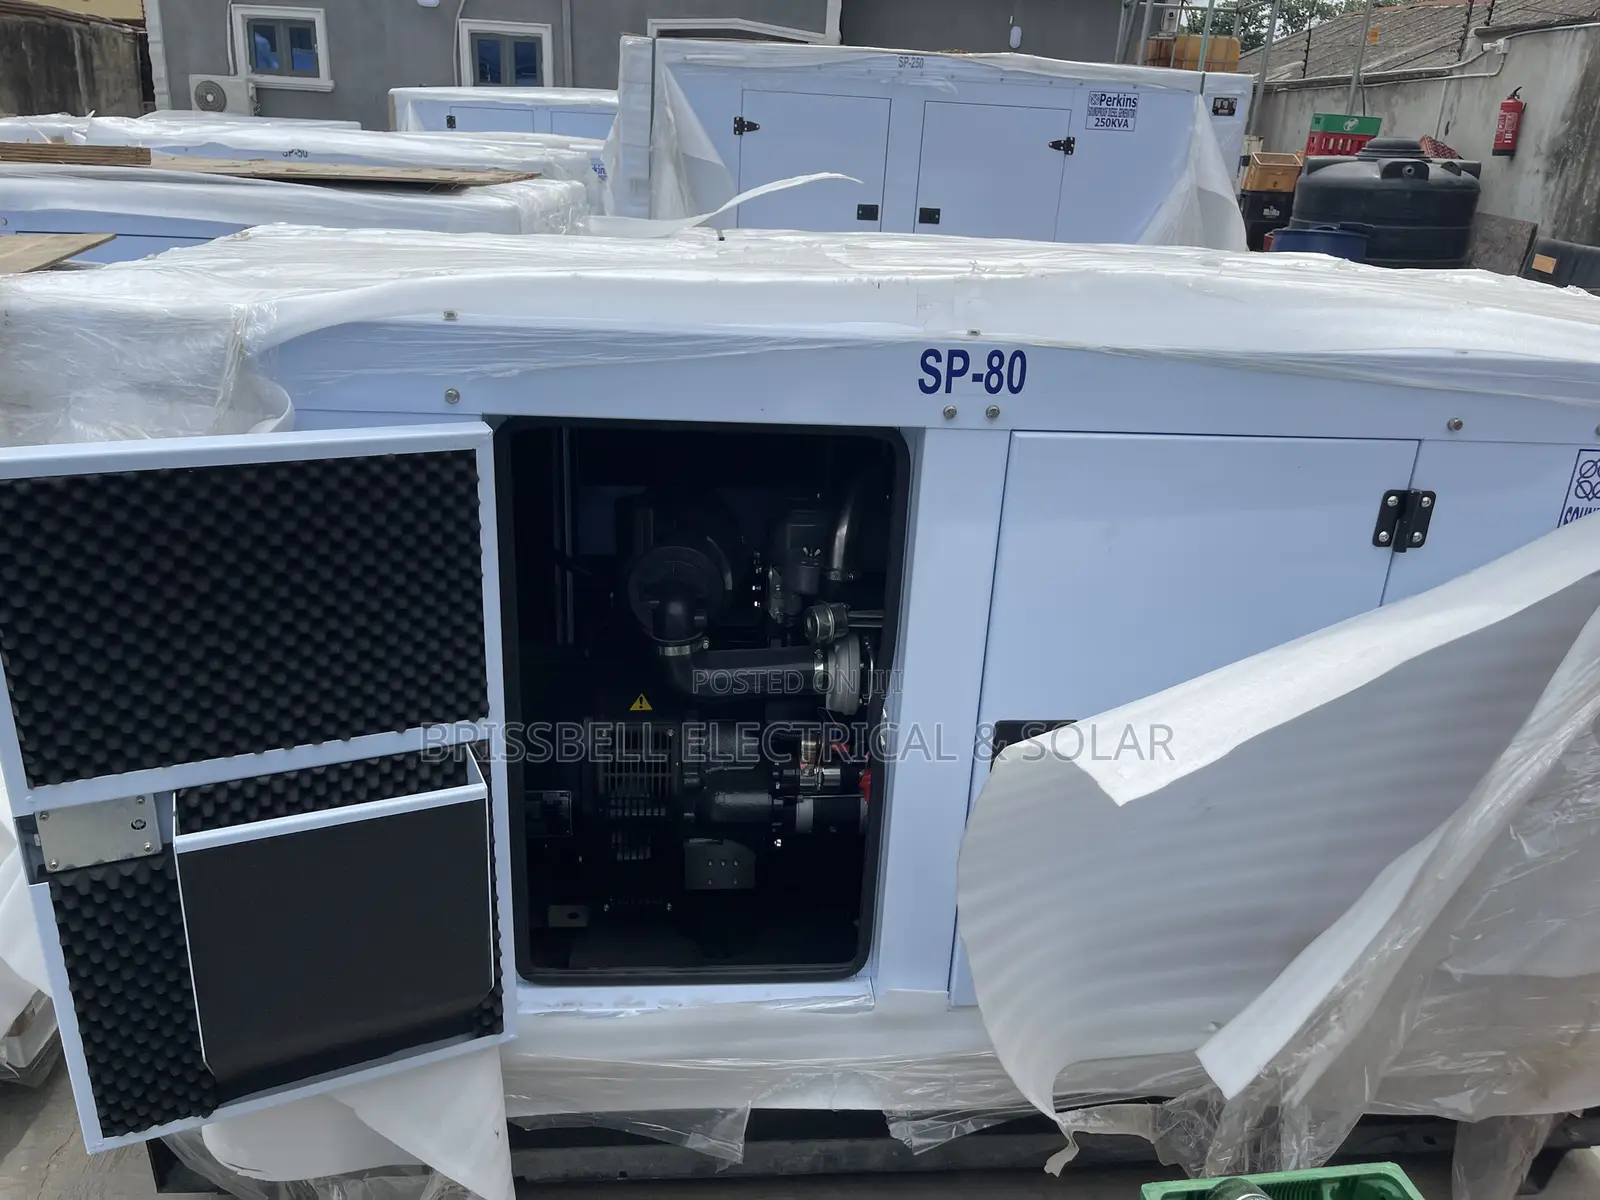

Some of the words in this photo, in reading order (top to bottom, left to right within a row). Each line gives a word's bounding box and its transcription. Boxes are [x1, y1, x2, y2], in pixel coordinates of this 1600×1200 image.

[898, 56, 925, 69] SP-250
[1100, 93, 1138, 108] Perkins
[1094, 117, 1129, 128] 250KVA
[918, 348, 1027, 395] SP-80
